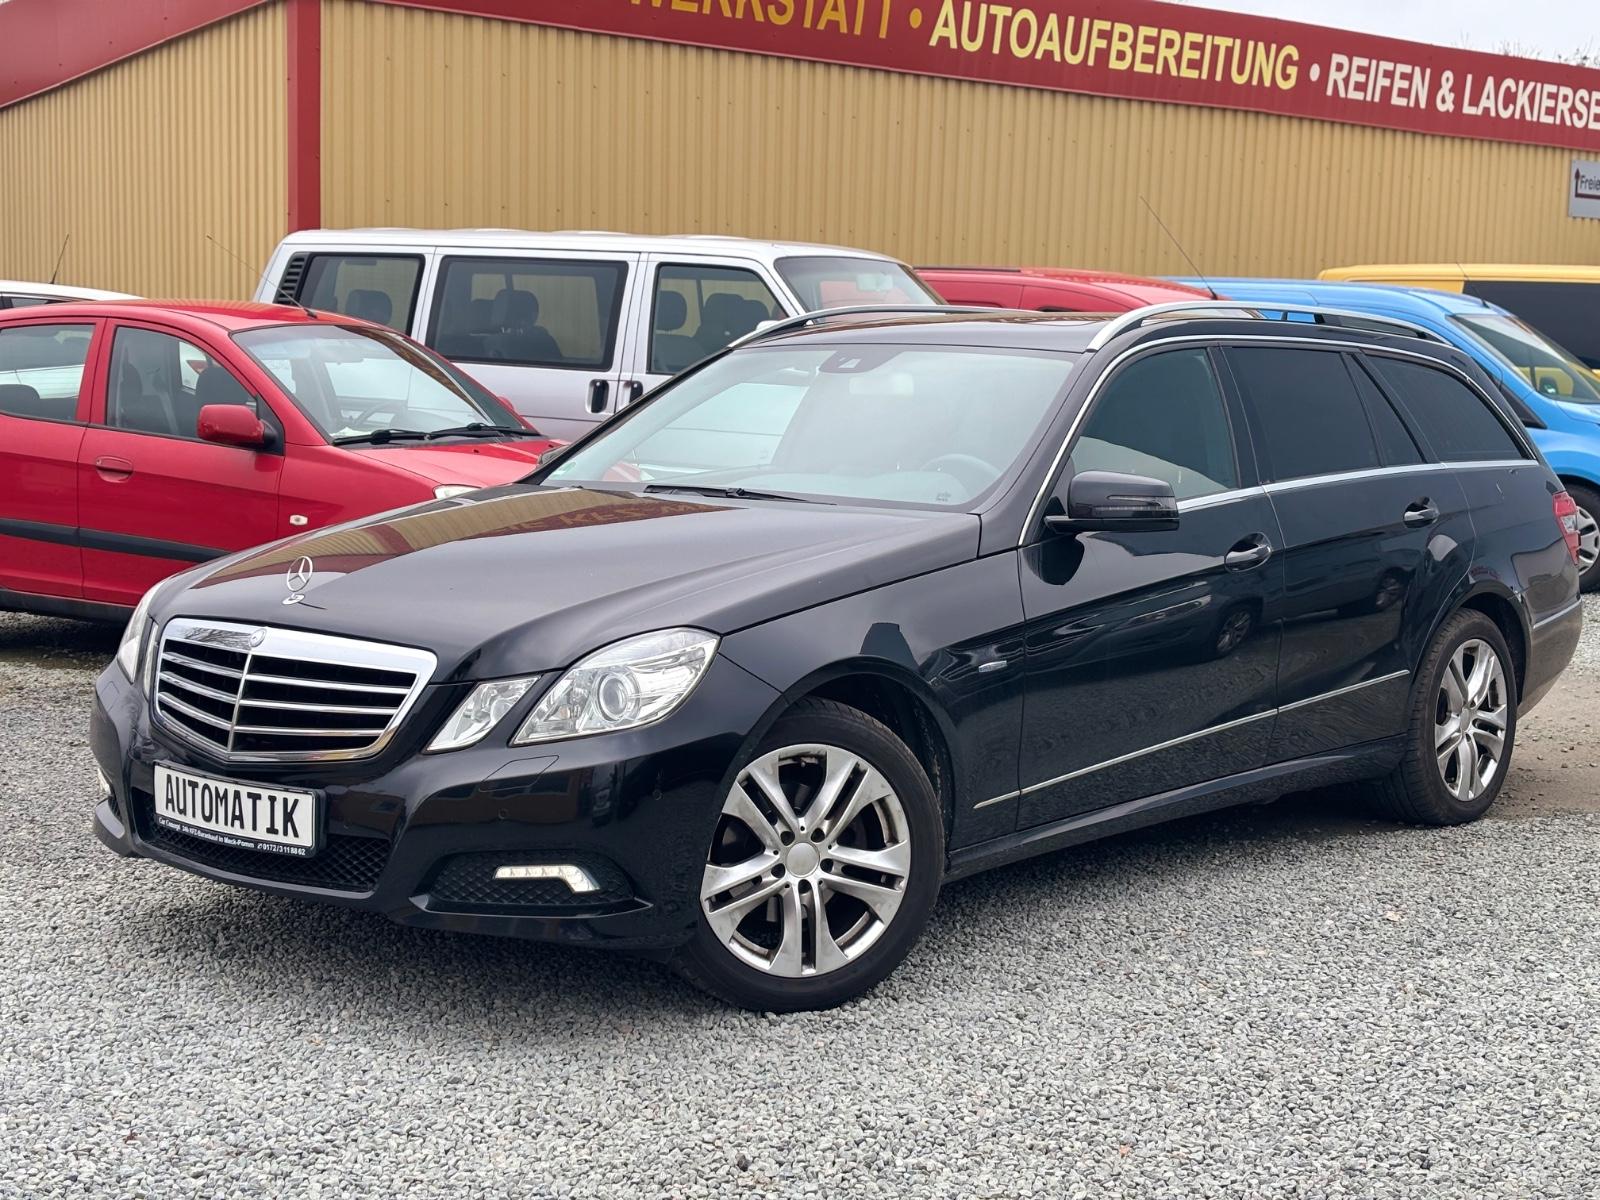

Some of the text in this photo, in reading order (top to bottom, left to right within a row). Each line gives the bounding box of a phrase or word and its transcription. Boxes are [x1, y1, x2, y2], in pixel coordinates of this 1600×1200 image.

[929, 0, 1300, 90] AUTOAUFBEREITUNG
[1326, 53, 1431, 109] REIFEN
[1436, 70, 1456, 113] &
[165, 773, 300, 838] AUTOMATIK
